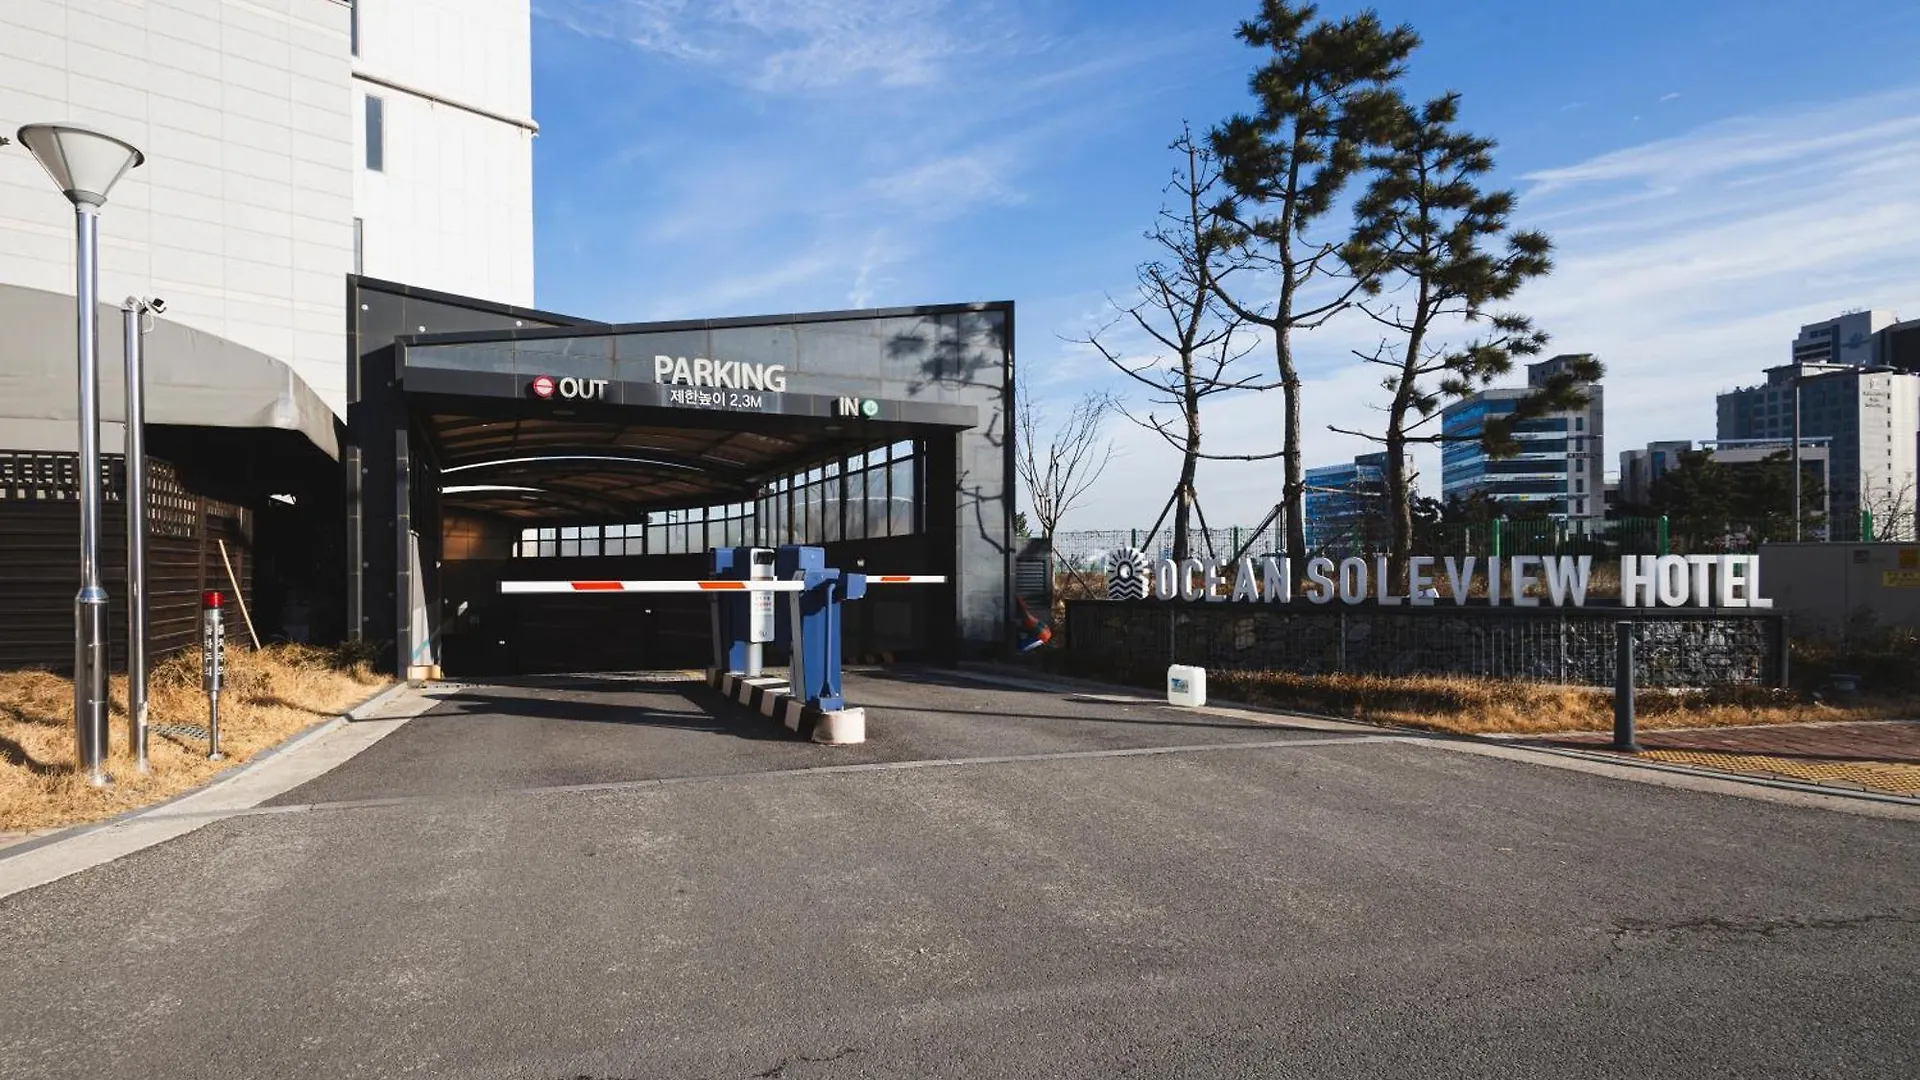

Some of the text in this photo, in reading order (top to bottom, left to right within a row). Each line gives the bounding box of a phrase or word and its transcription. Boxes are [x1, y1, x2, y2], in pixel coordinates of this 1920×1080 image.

[654, 355, 786, 393] PARKING
[560, 377, 609, 399] OUT
[670, 389, 762, 408] 제한높이 2.3M
[840, 397, 859, 416] IN
[1155, 554, 1773, 607] OCEAN SOLEVIEW HOTEL
